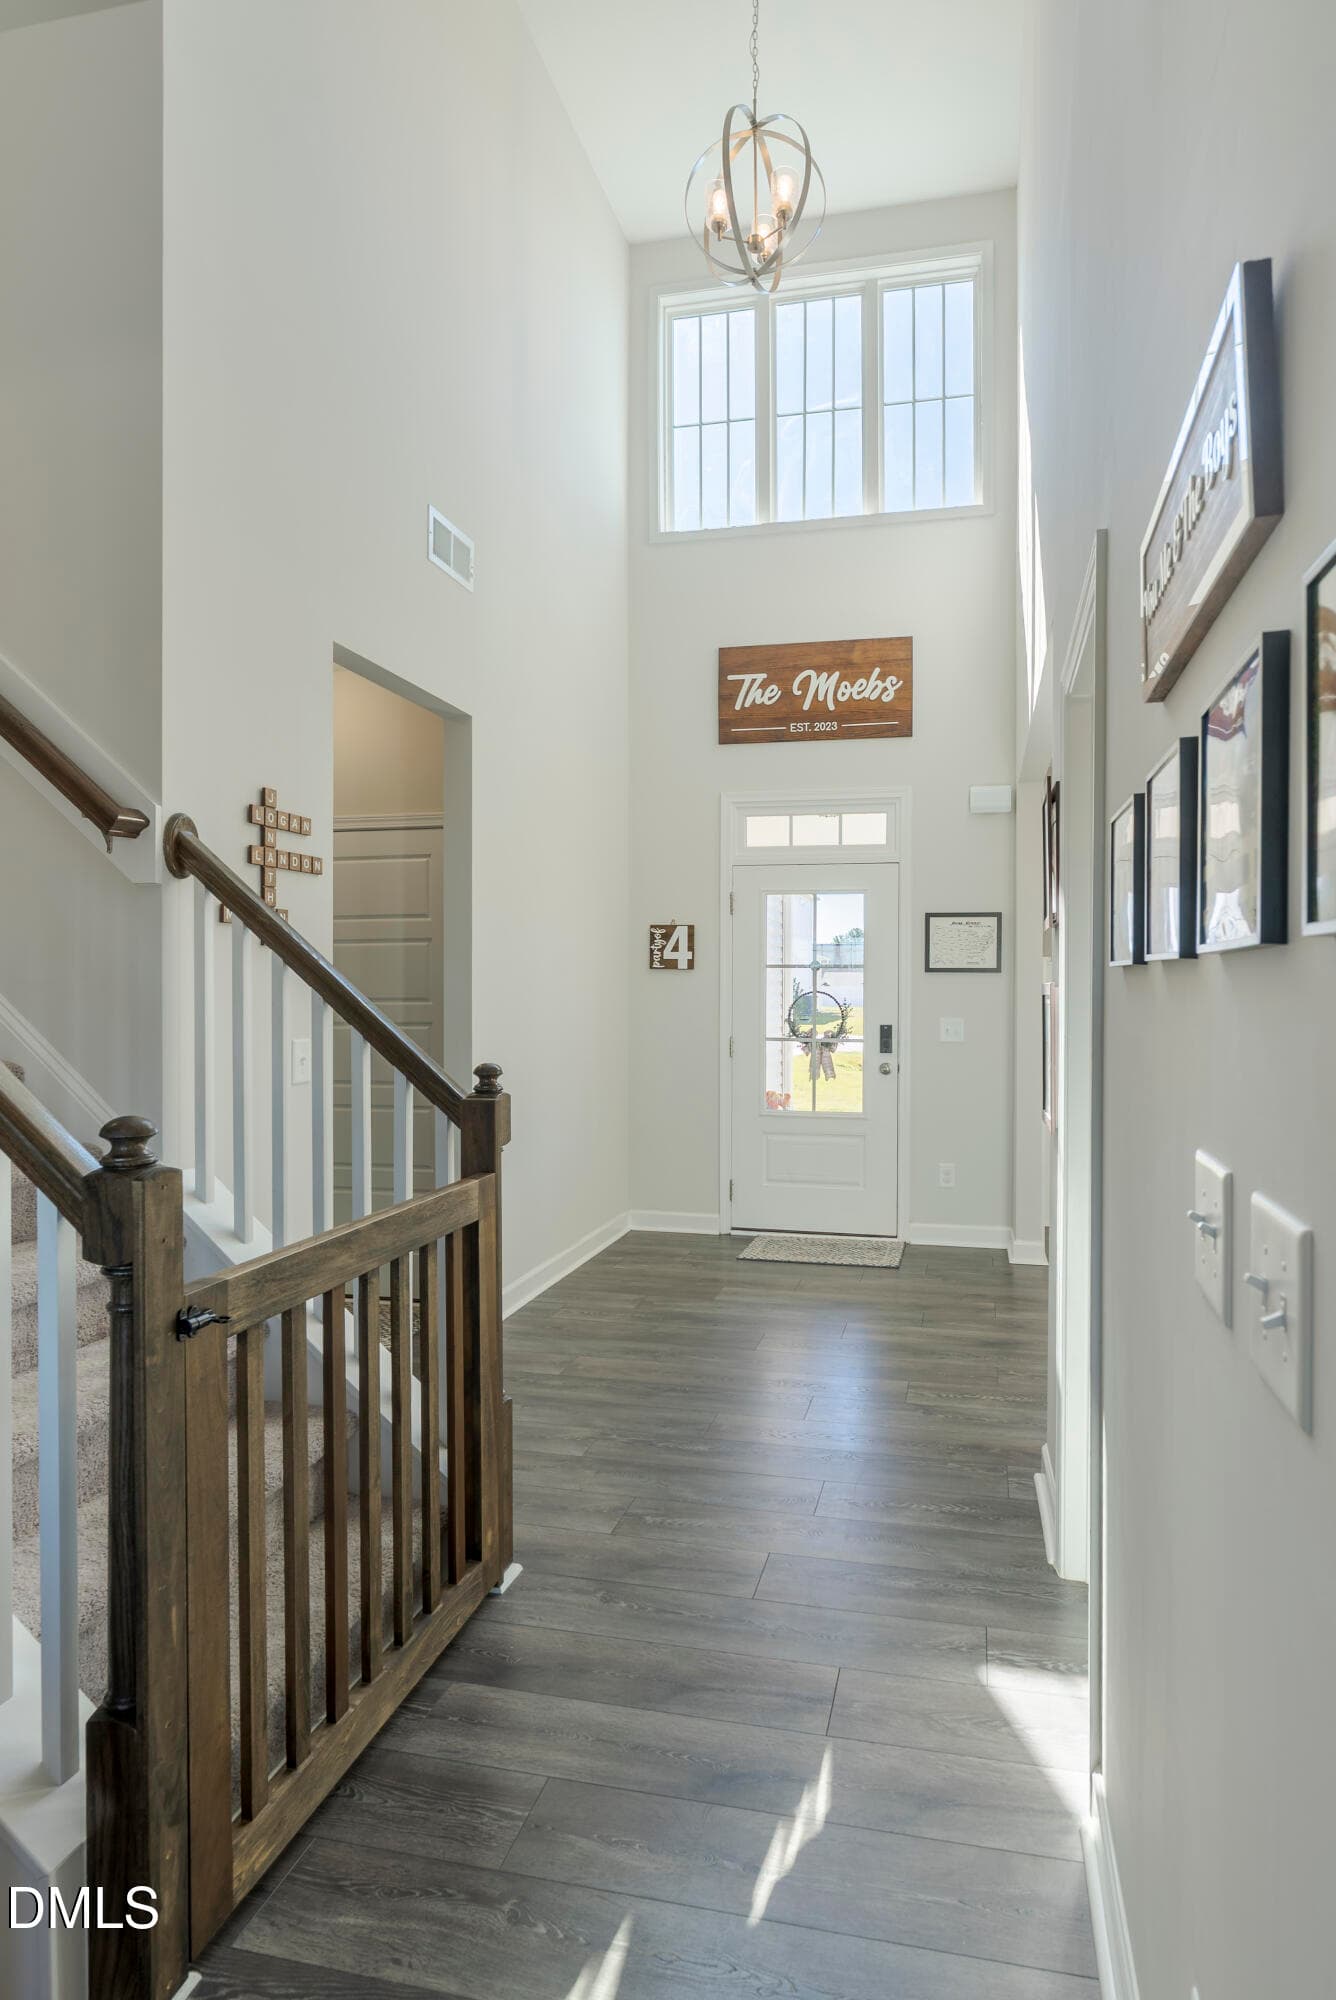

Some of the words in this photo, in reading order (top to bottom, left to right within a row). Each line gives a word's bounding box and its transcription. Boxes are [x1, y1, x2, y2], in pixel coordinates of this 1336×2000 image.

[1201, 391, 1238, 491] Boys
[727, 673, 781, 710] The
[792, 667, 903, 711] Moebs
[790, 723, 811, 732] EST.
[814, 722, 838, 731] 2023
[255, 807, 310, 831] LOGAN
[255, 850, 321, 871] LANDON
[663, 926, 692, 969] 4
